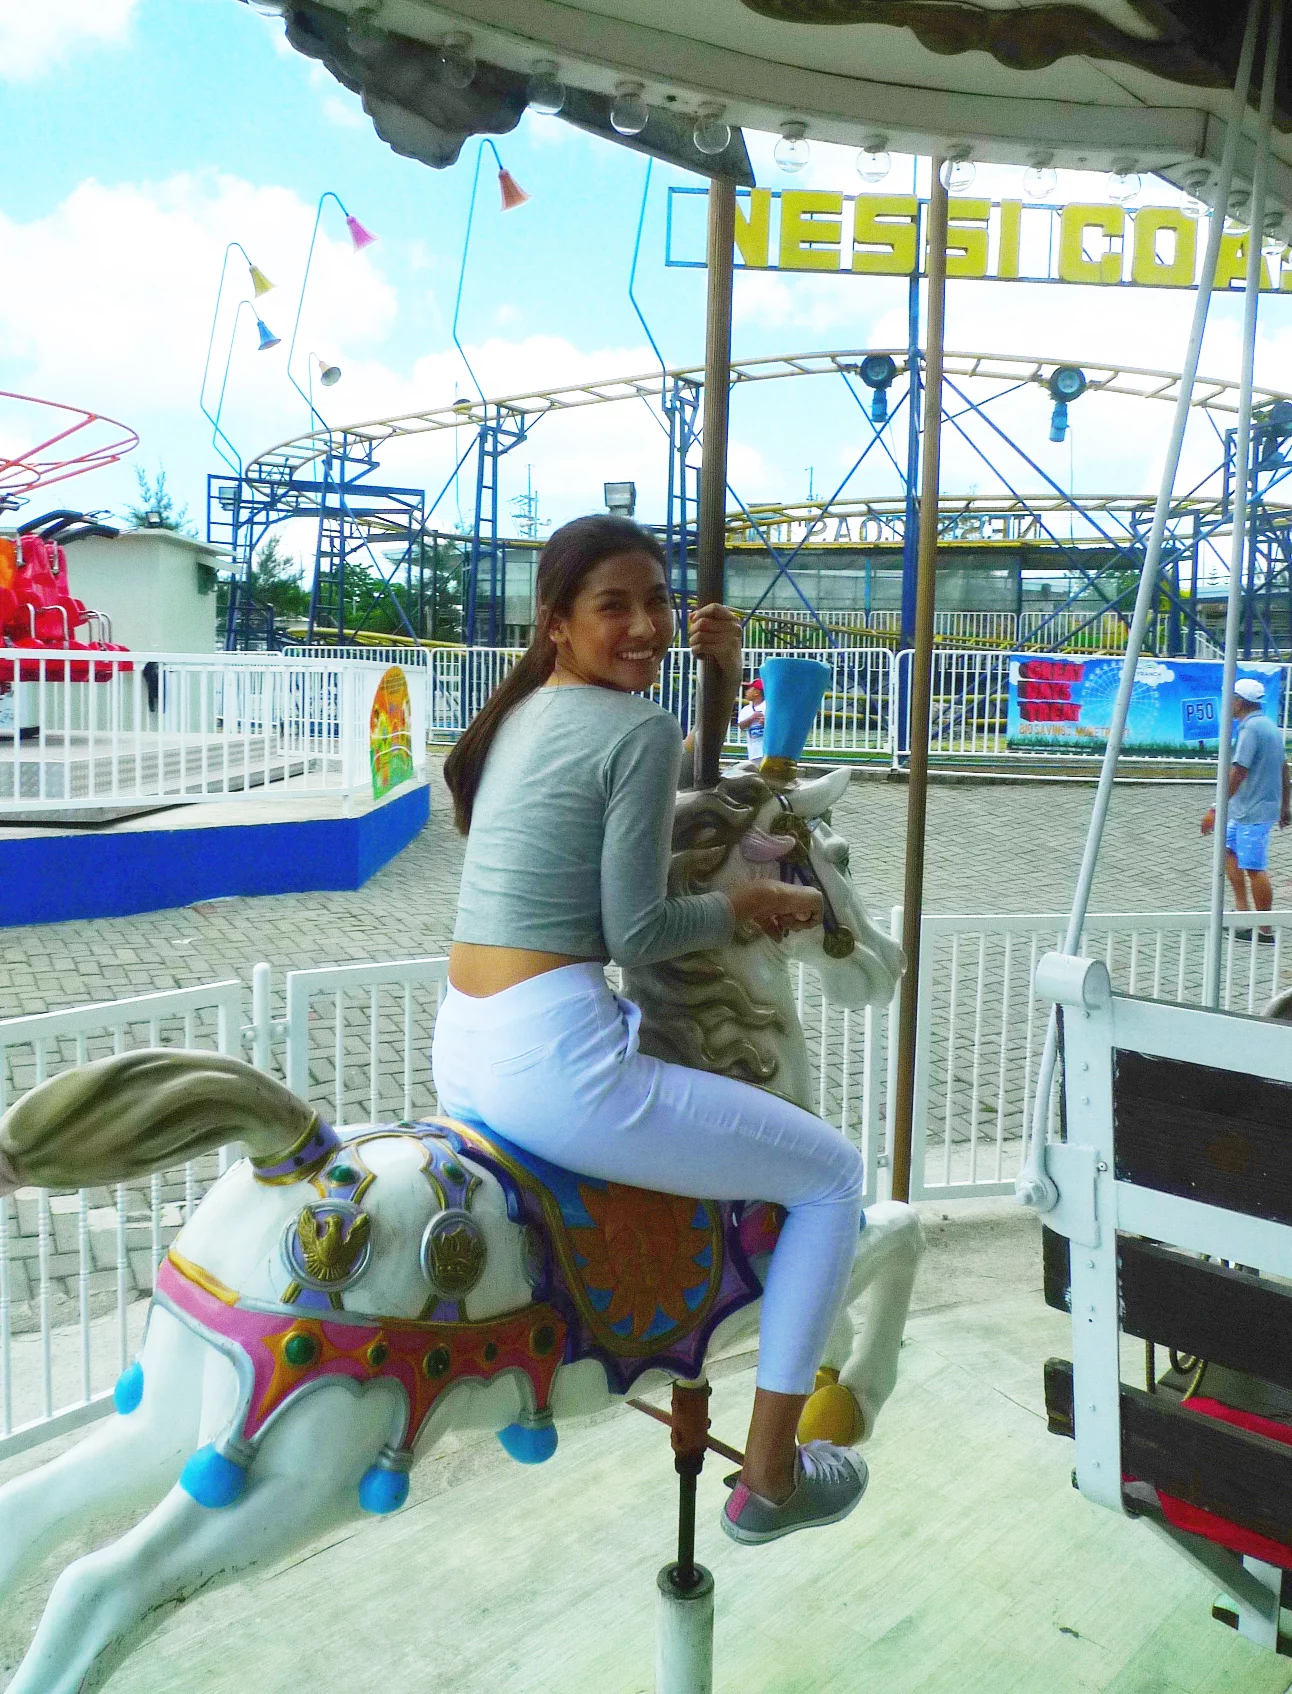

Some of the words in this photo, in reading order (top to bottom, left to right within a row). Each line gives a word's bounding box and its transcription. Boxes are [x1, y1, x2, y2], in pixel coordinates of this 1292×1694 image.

[733, 188, 1022, 279] NESSI
[1019, 660, 1084, 682] GREAT
[1186, 702, 1214, 722] P50
